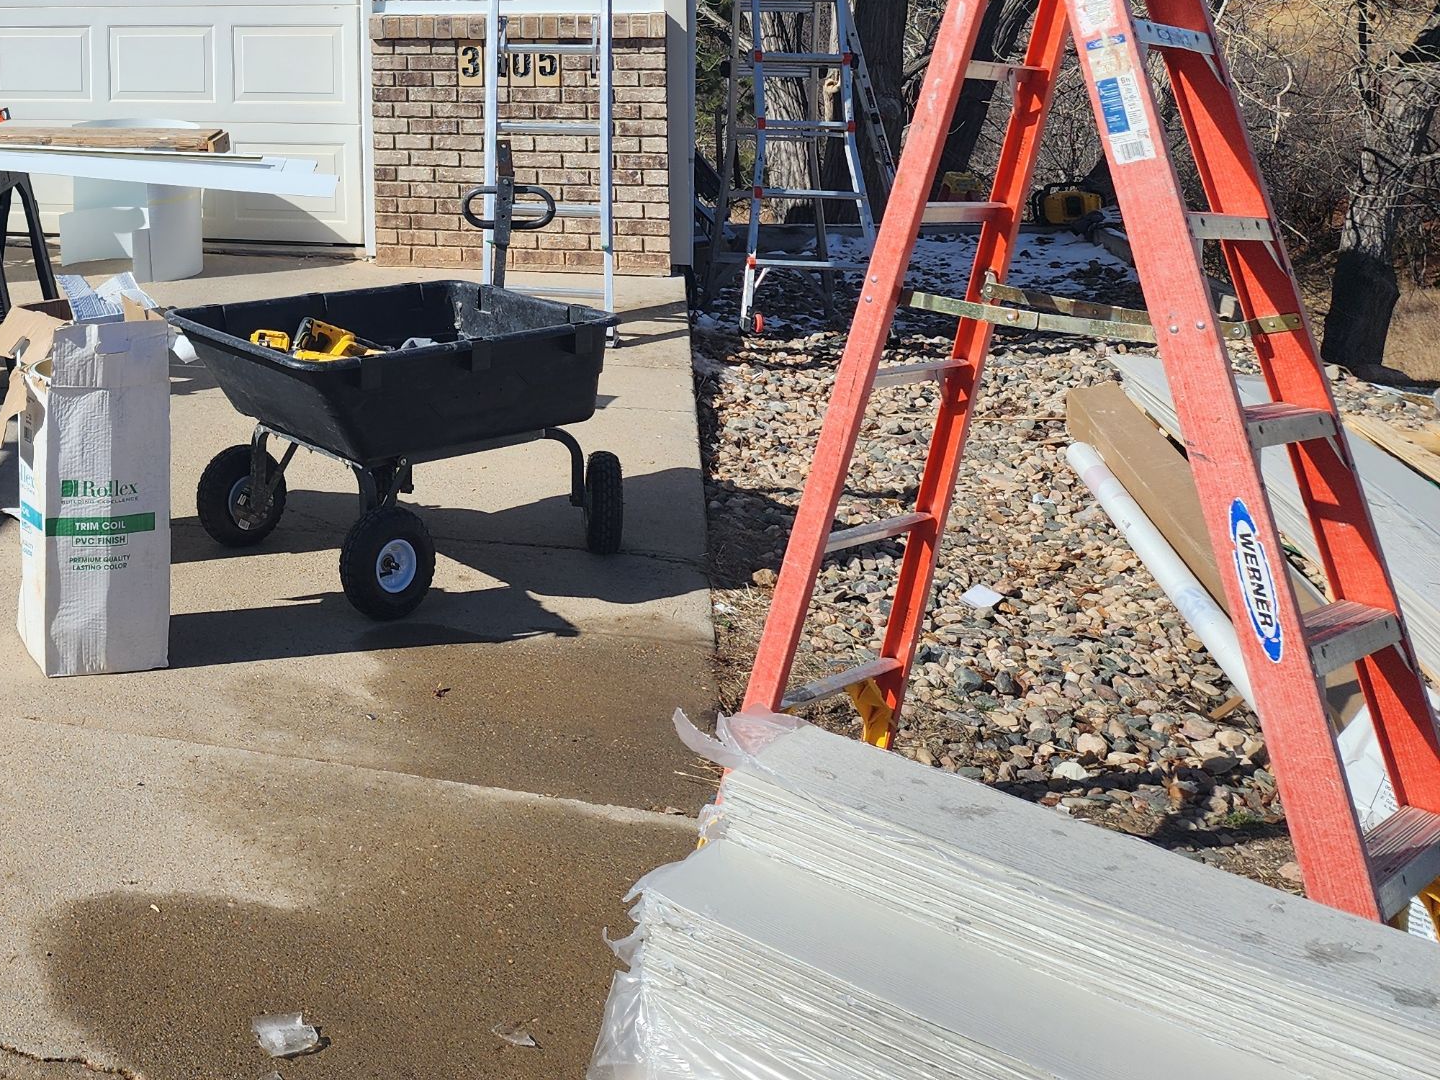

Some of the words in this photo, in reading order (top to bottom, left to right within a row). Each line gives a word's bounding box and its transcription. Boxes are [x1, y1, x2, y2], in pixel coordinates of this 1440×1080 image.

[461, 46, 557, 78] 305
[83, 480, 138, 497] Rollex
[75, 522, 99, 531] TRIM
[102, 521, 126, 530] COIL
[97, 536, 125, 545] FINISH
[103, 554, 130, 562] QUALITY
[1238, 532, 1274, 628] WERNER
